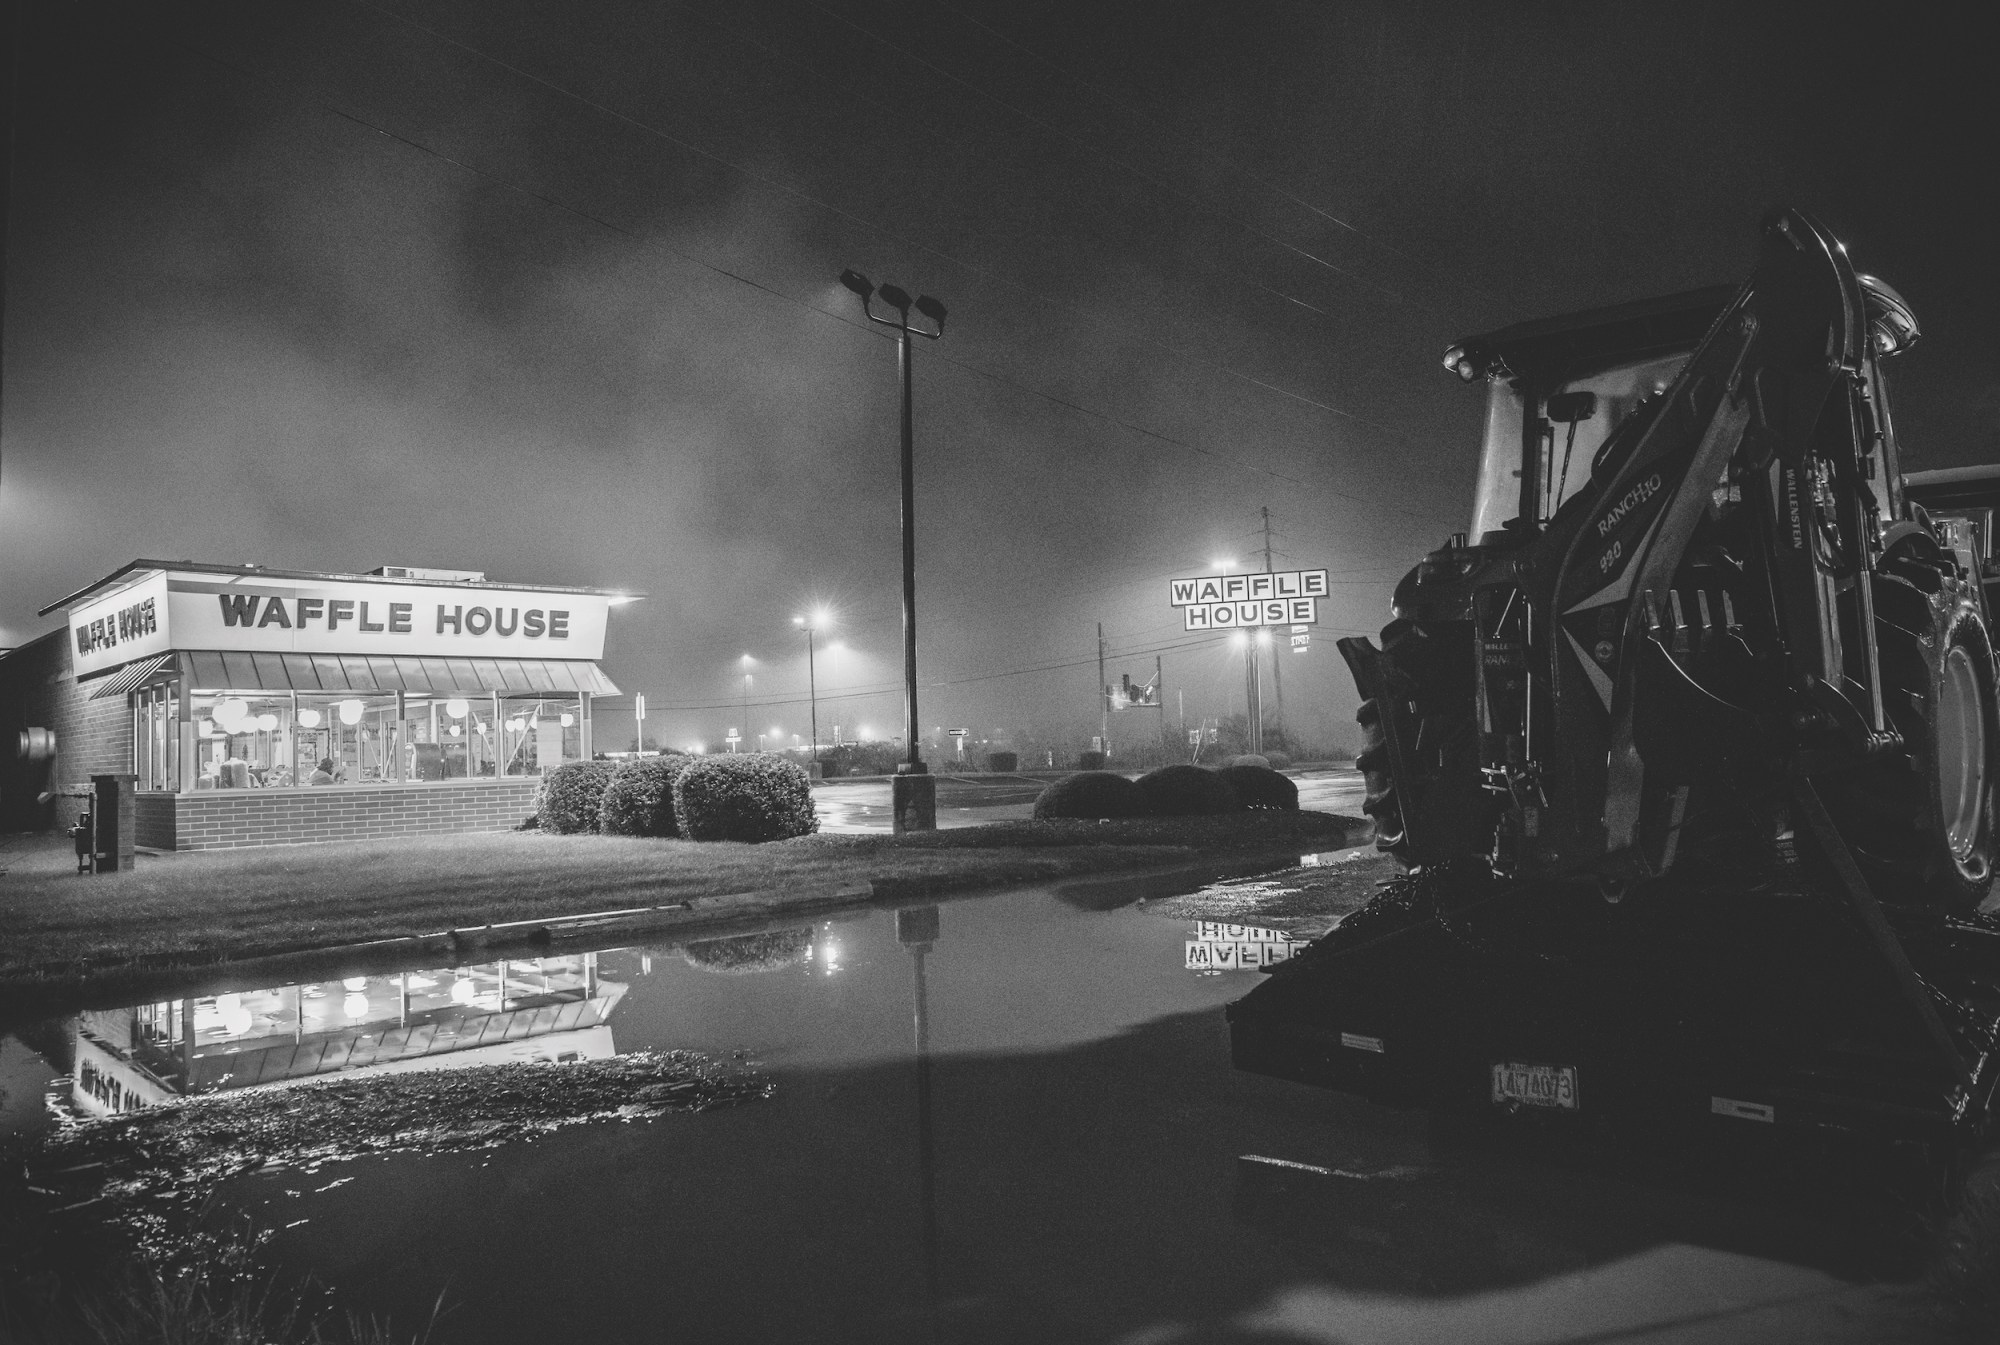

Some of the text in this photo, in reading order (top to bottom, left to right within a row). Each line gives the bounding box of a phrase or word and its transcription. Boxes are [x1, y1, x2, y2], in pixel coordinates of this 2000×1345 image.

[1597, 473, 1662, 538] RANCHO
[1786, 468, 1803, 549] WALLENSTEIN
[1174, 574, 1323, 601] WAFFLE
[219, 594, 570, 639] WAFFLE HOUSE
[1189, 601, 1310, 626] HOUSE
